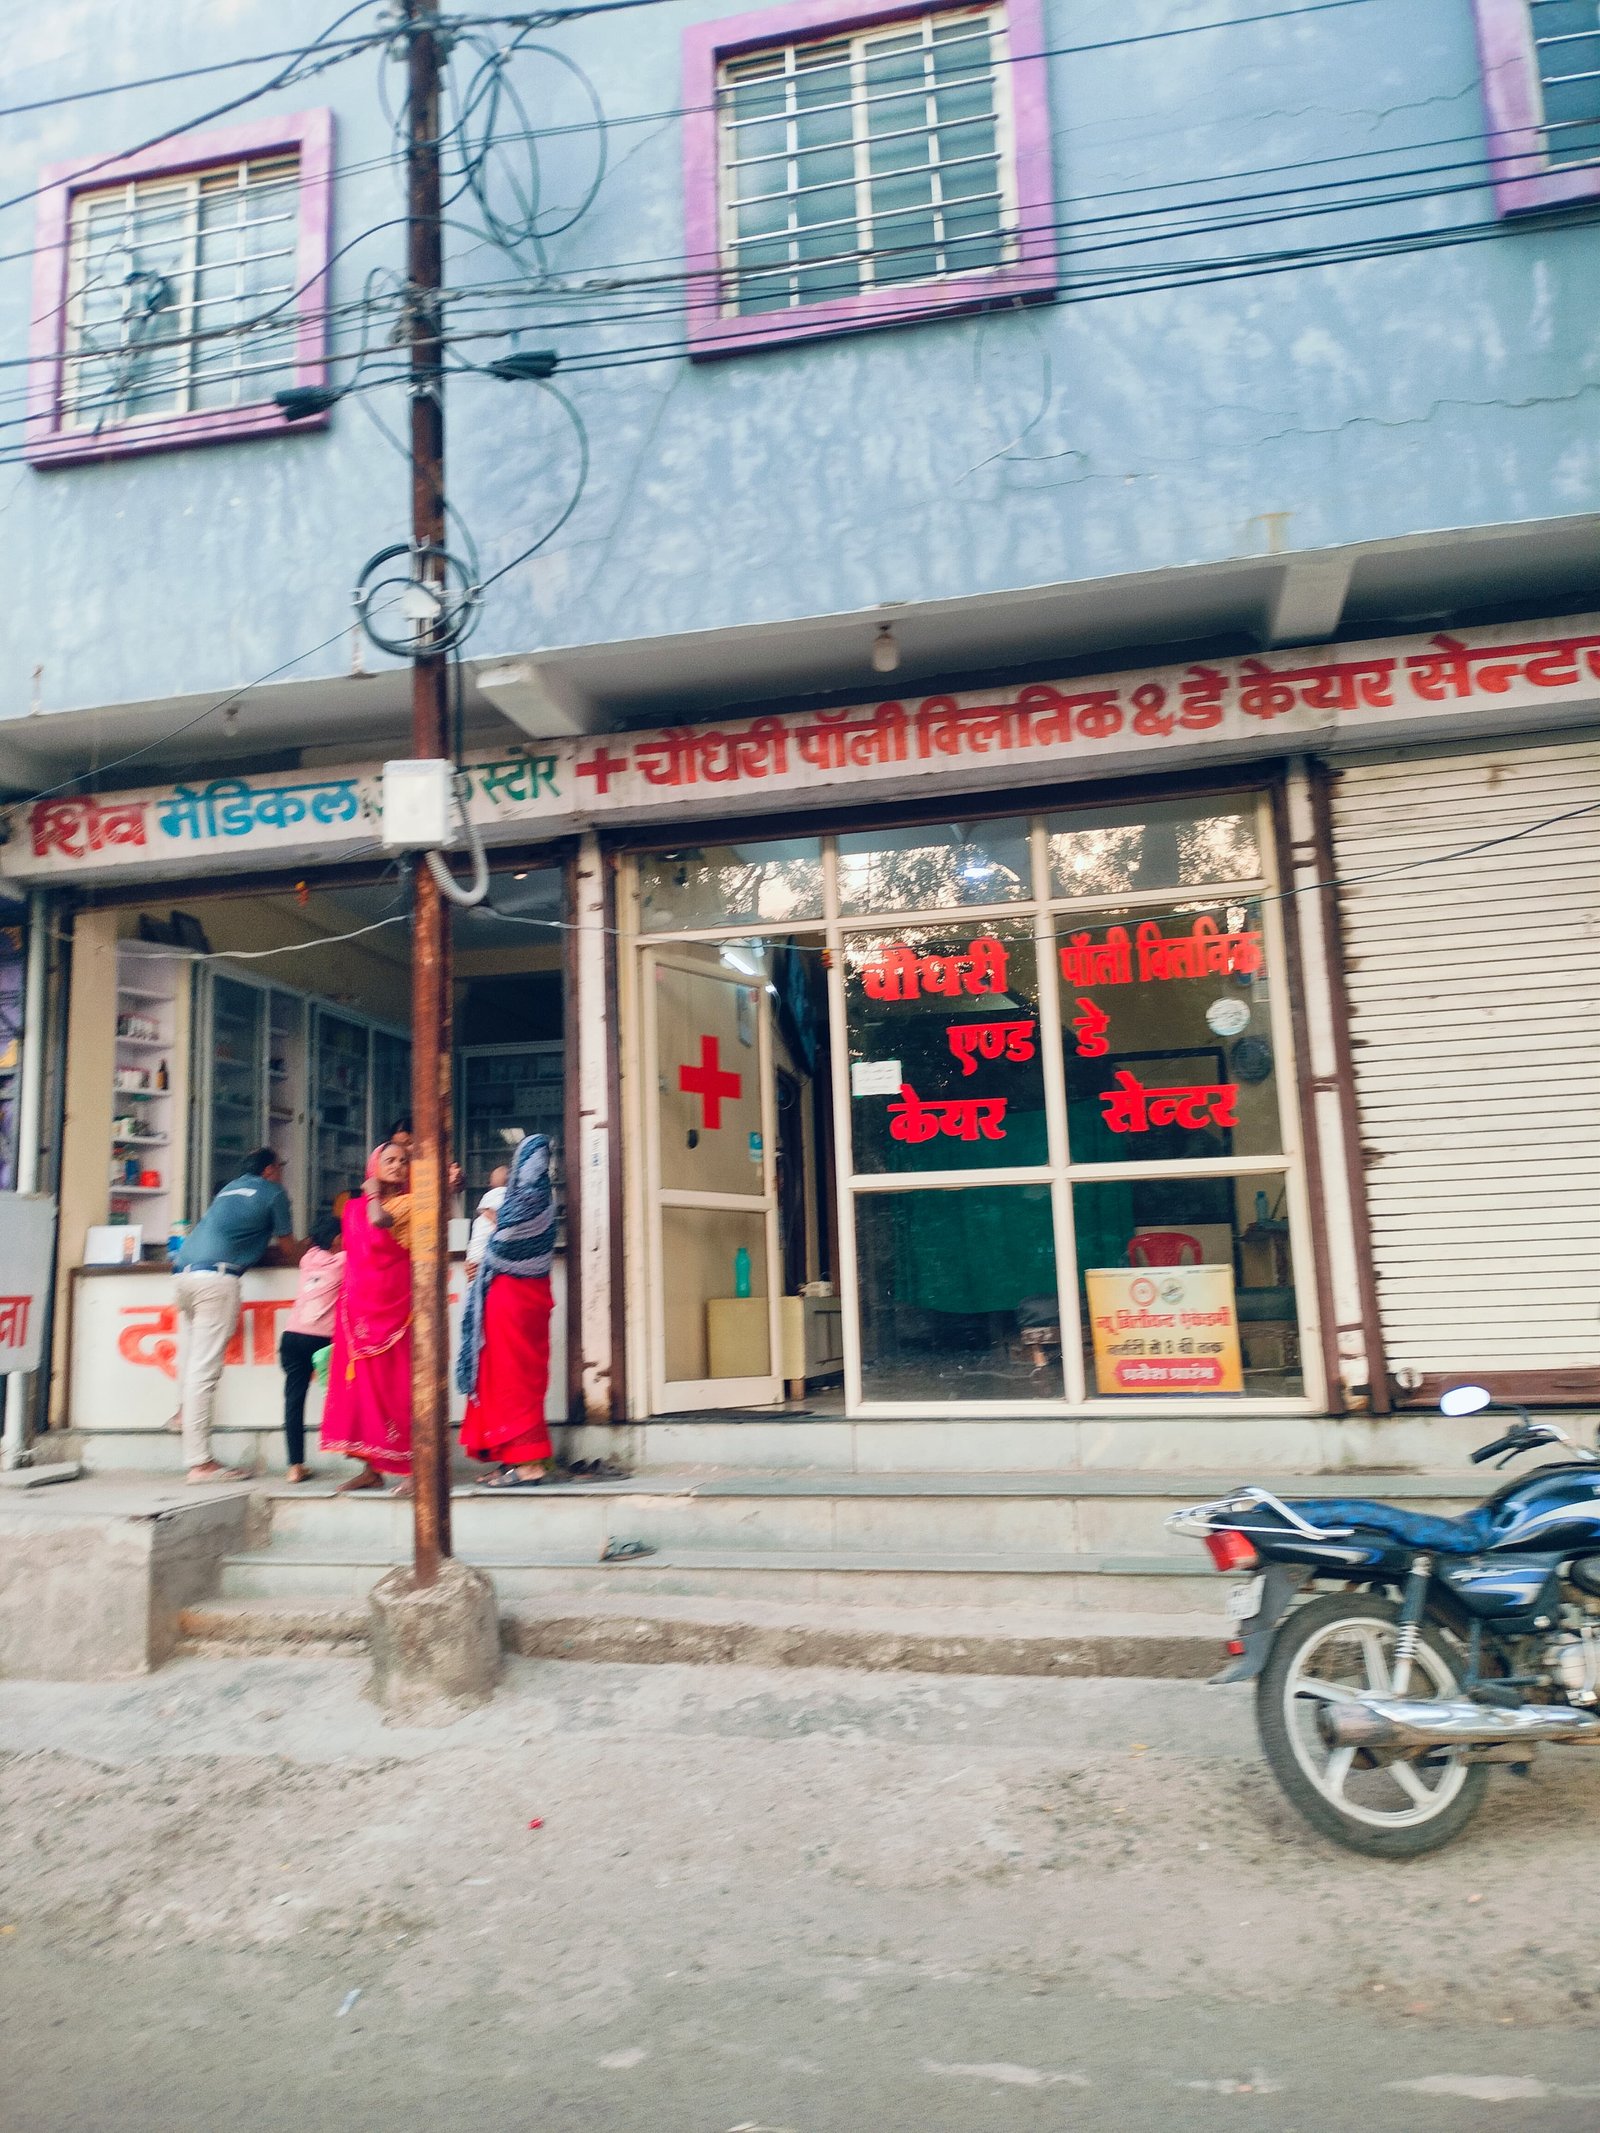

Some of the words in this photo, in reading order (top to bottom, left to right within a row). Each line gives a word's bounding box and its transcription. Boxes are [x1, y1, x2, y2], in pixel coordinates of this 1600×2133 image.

[634, 716, 790, 787] चौधरी
[794, 701, 910, 770] पॉली
[914, 684, 1124, 759] क्लिनिक
[1238, 657, 1398, 721] केयर
[30, 797, 149, 859] शिव
[946, 1020, 1036, 1076] एण्ड
[1072, 997, 1110, 1058] डे
[887, 1083, 1008, 1143] केयर
[1099, 1070, 1240, 1133] सेन्टर
